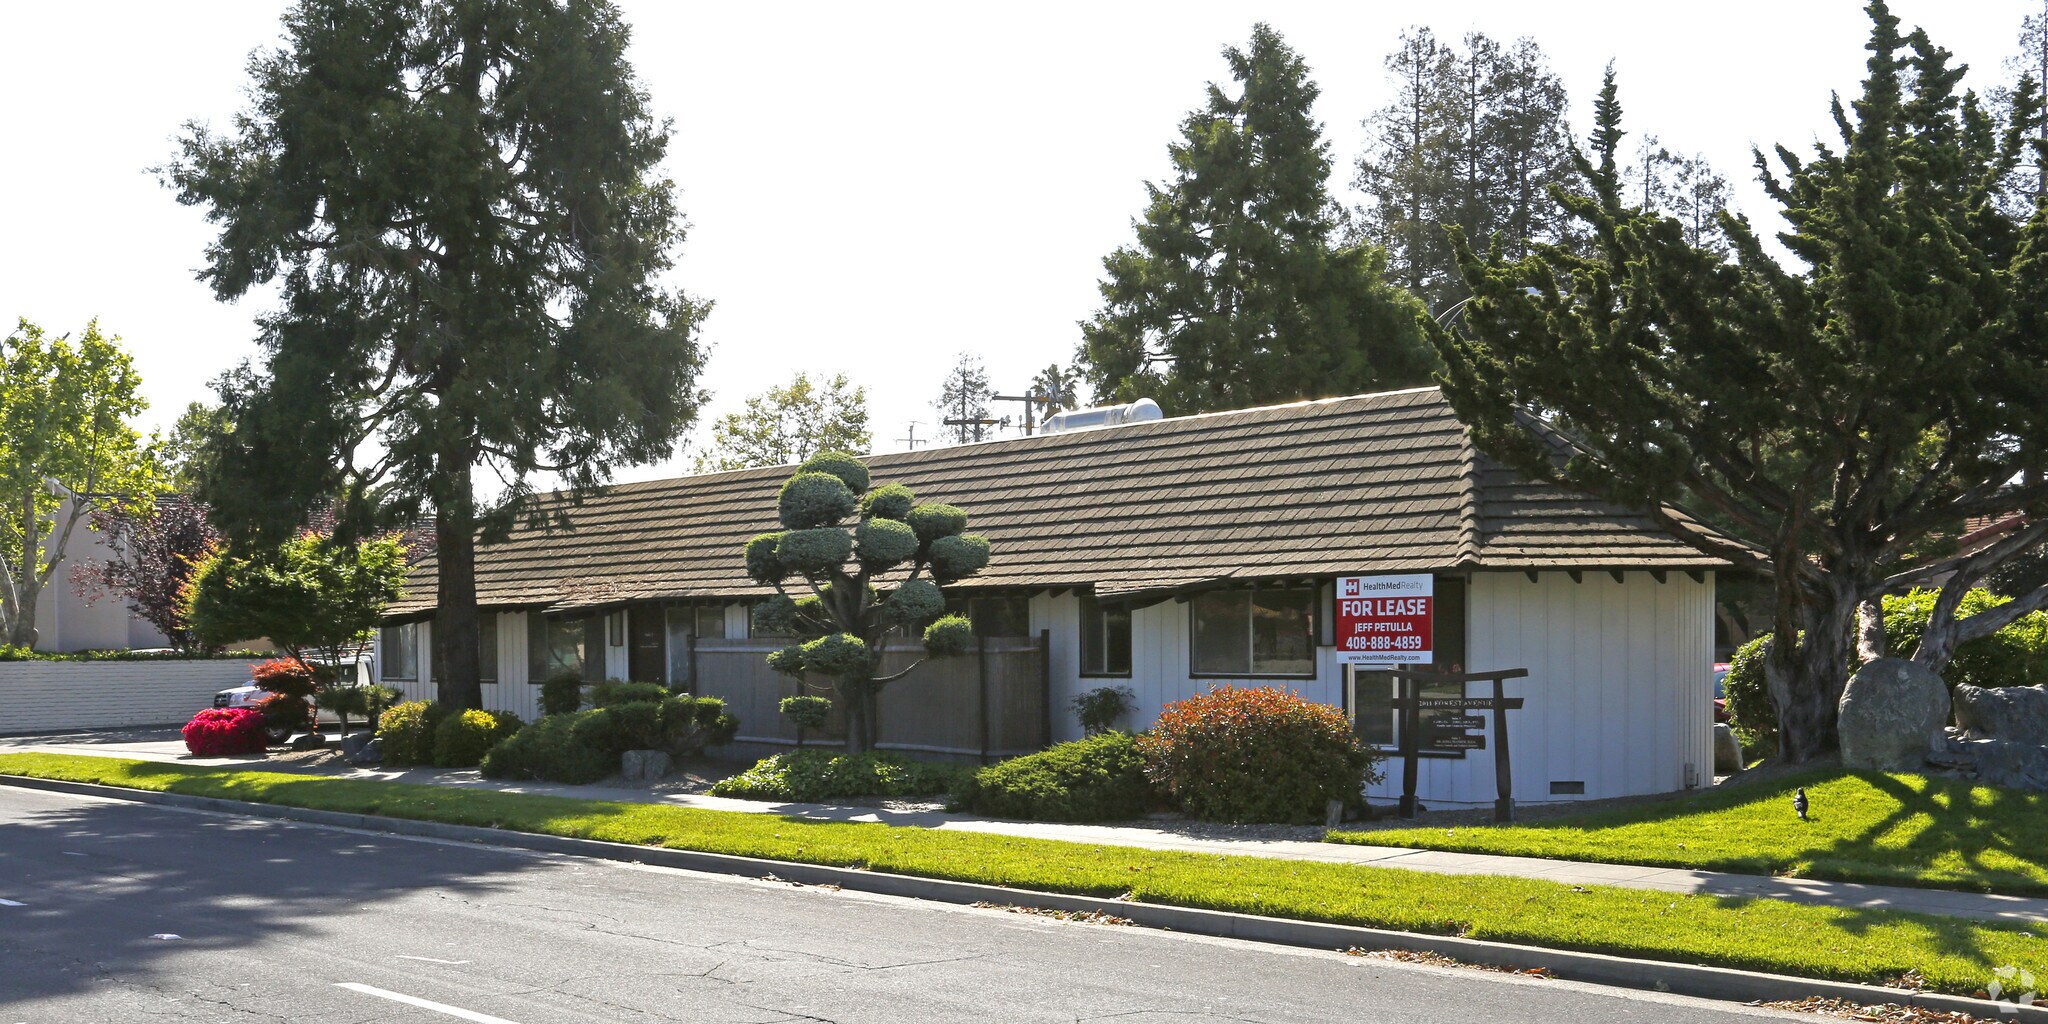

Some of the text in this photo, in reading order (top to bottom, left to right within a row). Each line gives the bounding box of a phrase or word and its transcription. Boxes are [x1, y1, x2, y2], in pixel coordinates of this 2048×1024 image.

[1363, 581, 1423, 591] HealthMedRealty
[1342, 599, 1426, 617] FOR LEASE
[1354, 622, 1413, 634] JEFF PETULLA
[1346, 636, 1422, 650] 408-888-4859
[1348, 654, 1420, 662] www.HealthMedRealty.com
